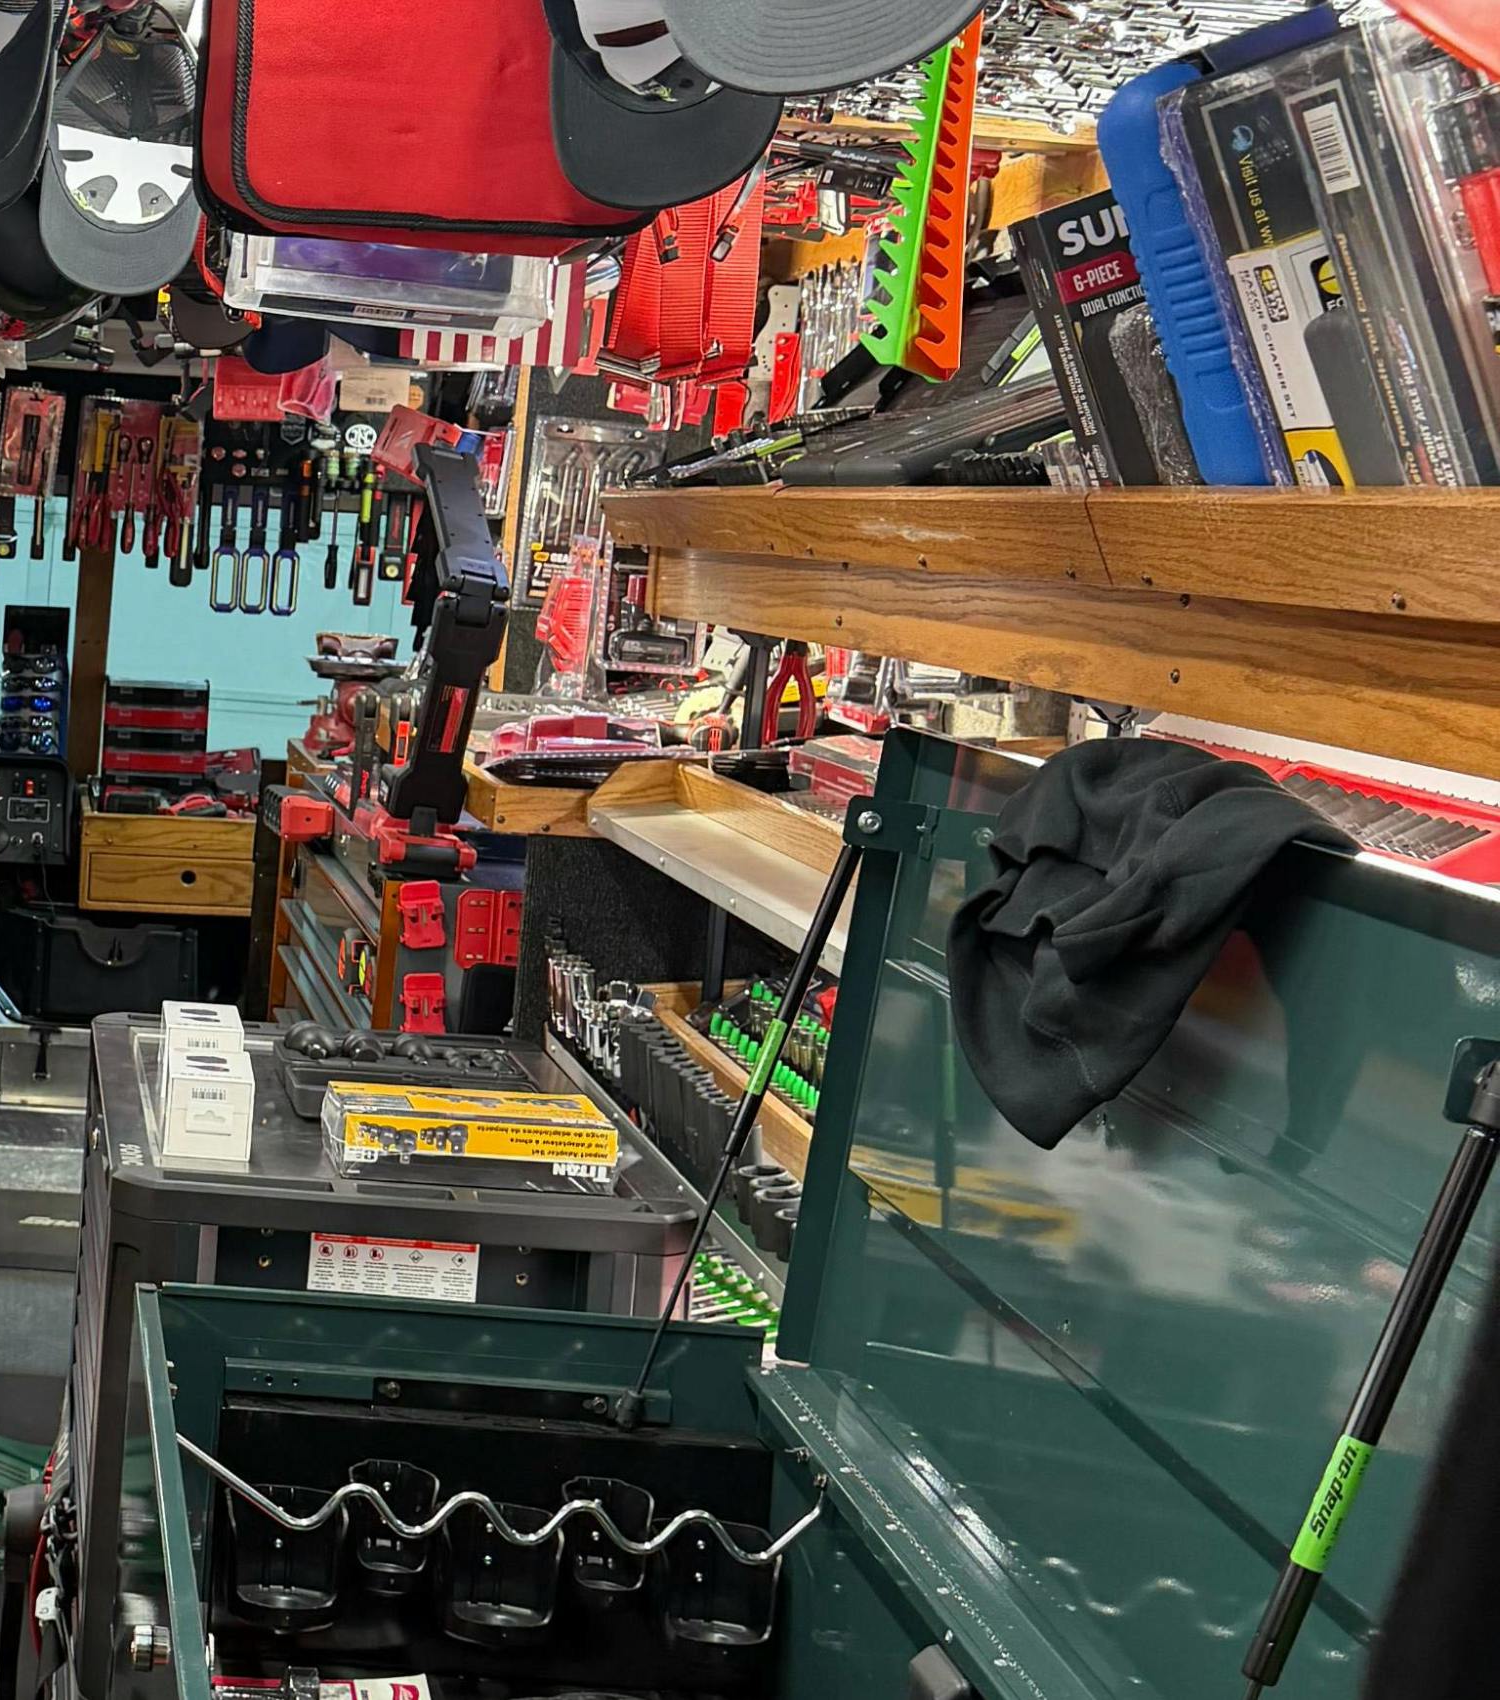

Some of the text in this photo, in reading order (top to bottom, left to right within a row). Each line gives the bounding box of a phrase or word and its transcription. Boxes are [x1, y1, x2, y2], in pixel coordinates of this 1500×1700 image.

[1239, 153, 1257, 186] Visit
[1248, 189, 1263, 207] us
[1254, 207, 1271, 225] at
[1073, 260, 1123, 292] 6-PIECE
[1081, 298, 1108, 317] DUAL
[1268, 278, 1289, 317] DENT
[1240, 268, 1266, 321] RAZOR
[1258, 322, 1289, 390] SCRAPER
[1281, 392, 1297, 420] SET
[1360, 315, 1380, 355] Tool
[1397, 356, 1414, 385] NUT
[1376, 359, 1411, 448] Pneumatic
[1406, 386, 1426, 422] AXLE
[1417, 423, 1446, 486] 12-POINT
[547, 1149, 578, 1157] Adapter
[580, 1150, 608, 1159] Impact
[552, 1162, 611, 1184] TITAN
[1310, 1444, 1358, 1540] Snap-on
